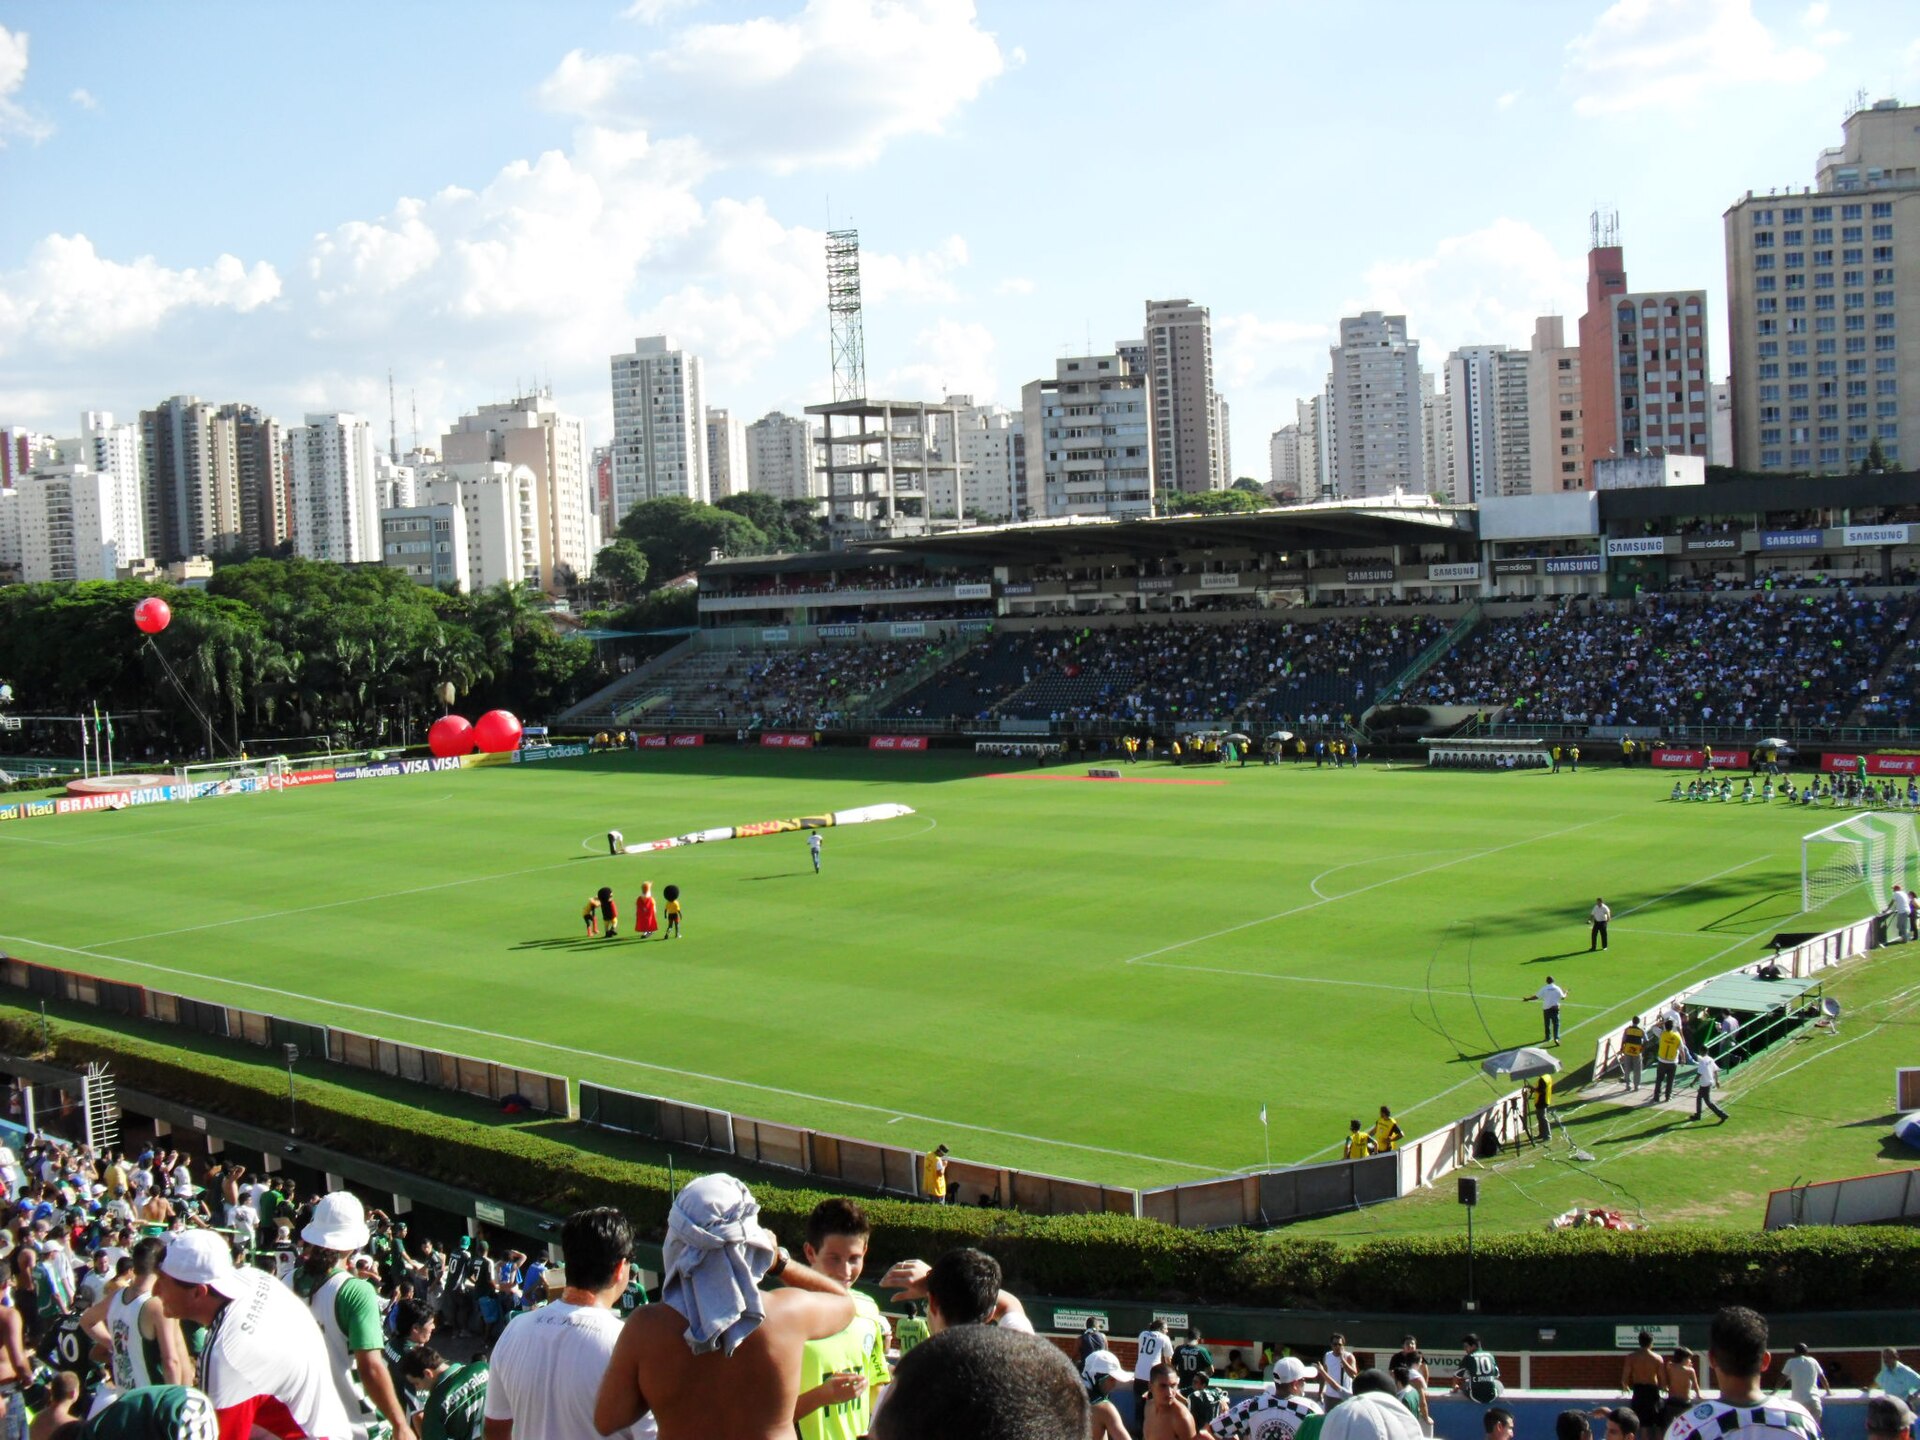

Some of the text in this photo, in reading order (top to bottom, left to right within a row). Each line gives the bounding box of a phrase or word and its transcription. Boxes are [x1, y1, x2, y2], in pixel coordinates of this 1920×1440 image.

[1766, 534, 1817, 546] SAMSUNG
[1849, 529, 1903, 542] SAMSUNG
[1609, 540, 1662, 553] SAMSUNG
[1706, 539, 1735, 549] adidas
[1433, 566, 1475, 577] SAMSUNG
[1509, 563, 1532, 571] adidas
[1546, 560, 1598, 571] SAMSUNG
[1204, 577, 1236, 586] SAMSUNG
[1347, 570, 1393, 581] SAMSUNG
[1138, 580, 1173, 589] SAMSUNG
[548, 745, 584, 758] adidas
[402, 760, 430, 774] VISA
[430, 757, 460, 770] VISA
[335, 764, 400, 779] Cursos Microlins
[270, 774, 299, 787] CNA
[130, 782, 200, 805] FATAL SURF
[60, 792, 130, 813] BRAHMA
[27, 802, 54, 818] Itaú
[1140, 1336, 1156, 1355] 10
[1182, 1355, 1197, 1371] 10
[1474, 1355, 1492, 1375] 10
[441, 1369, 489, 1414] parmala
